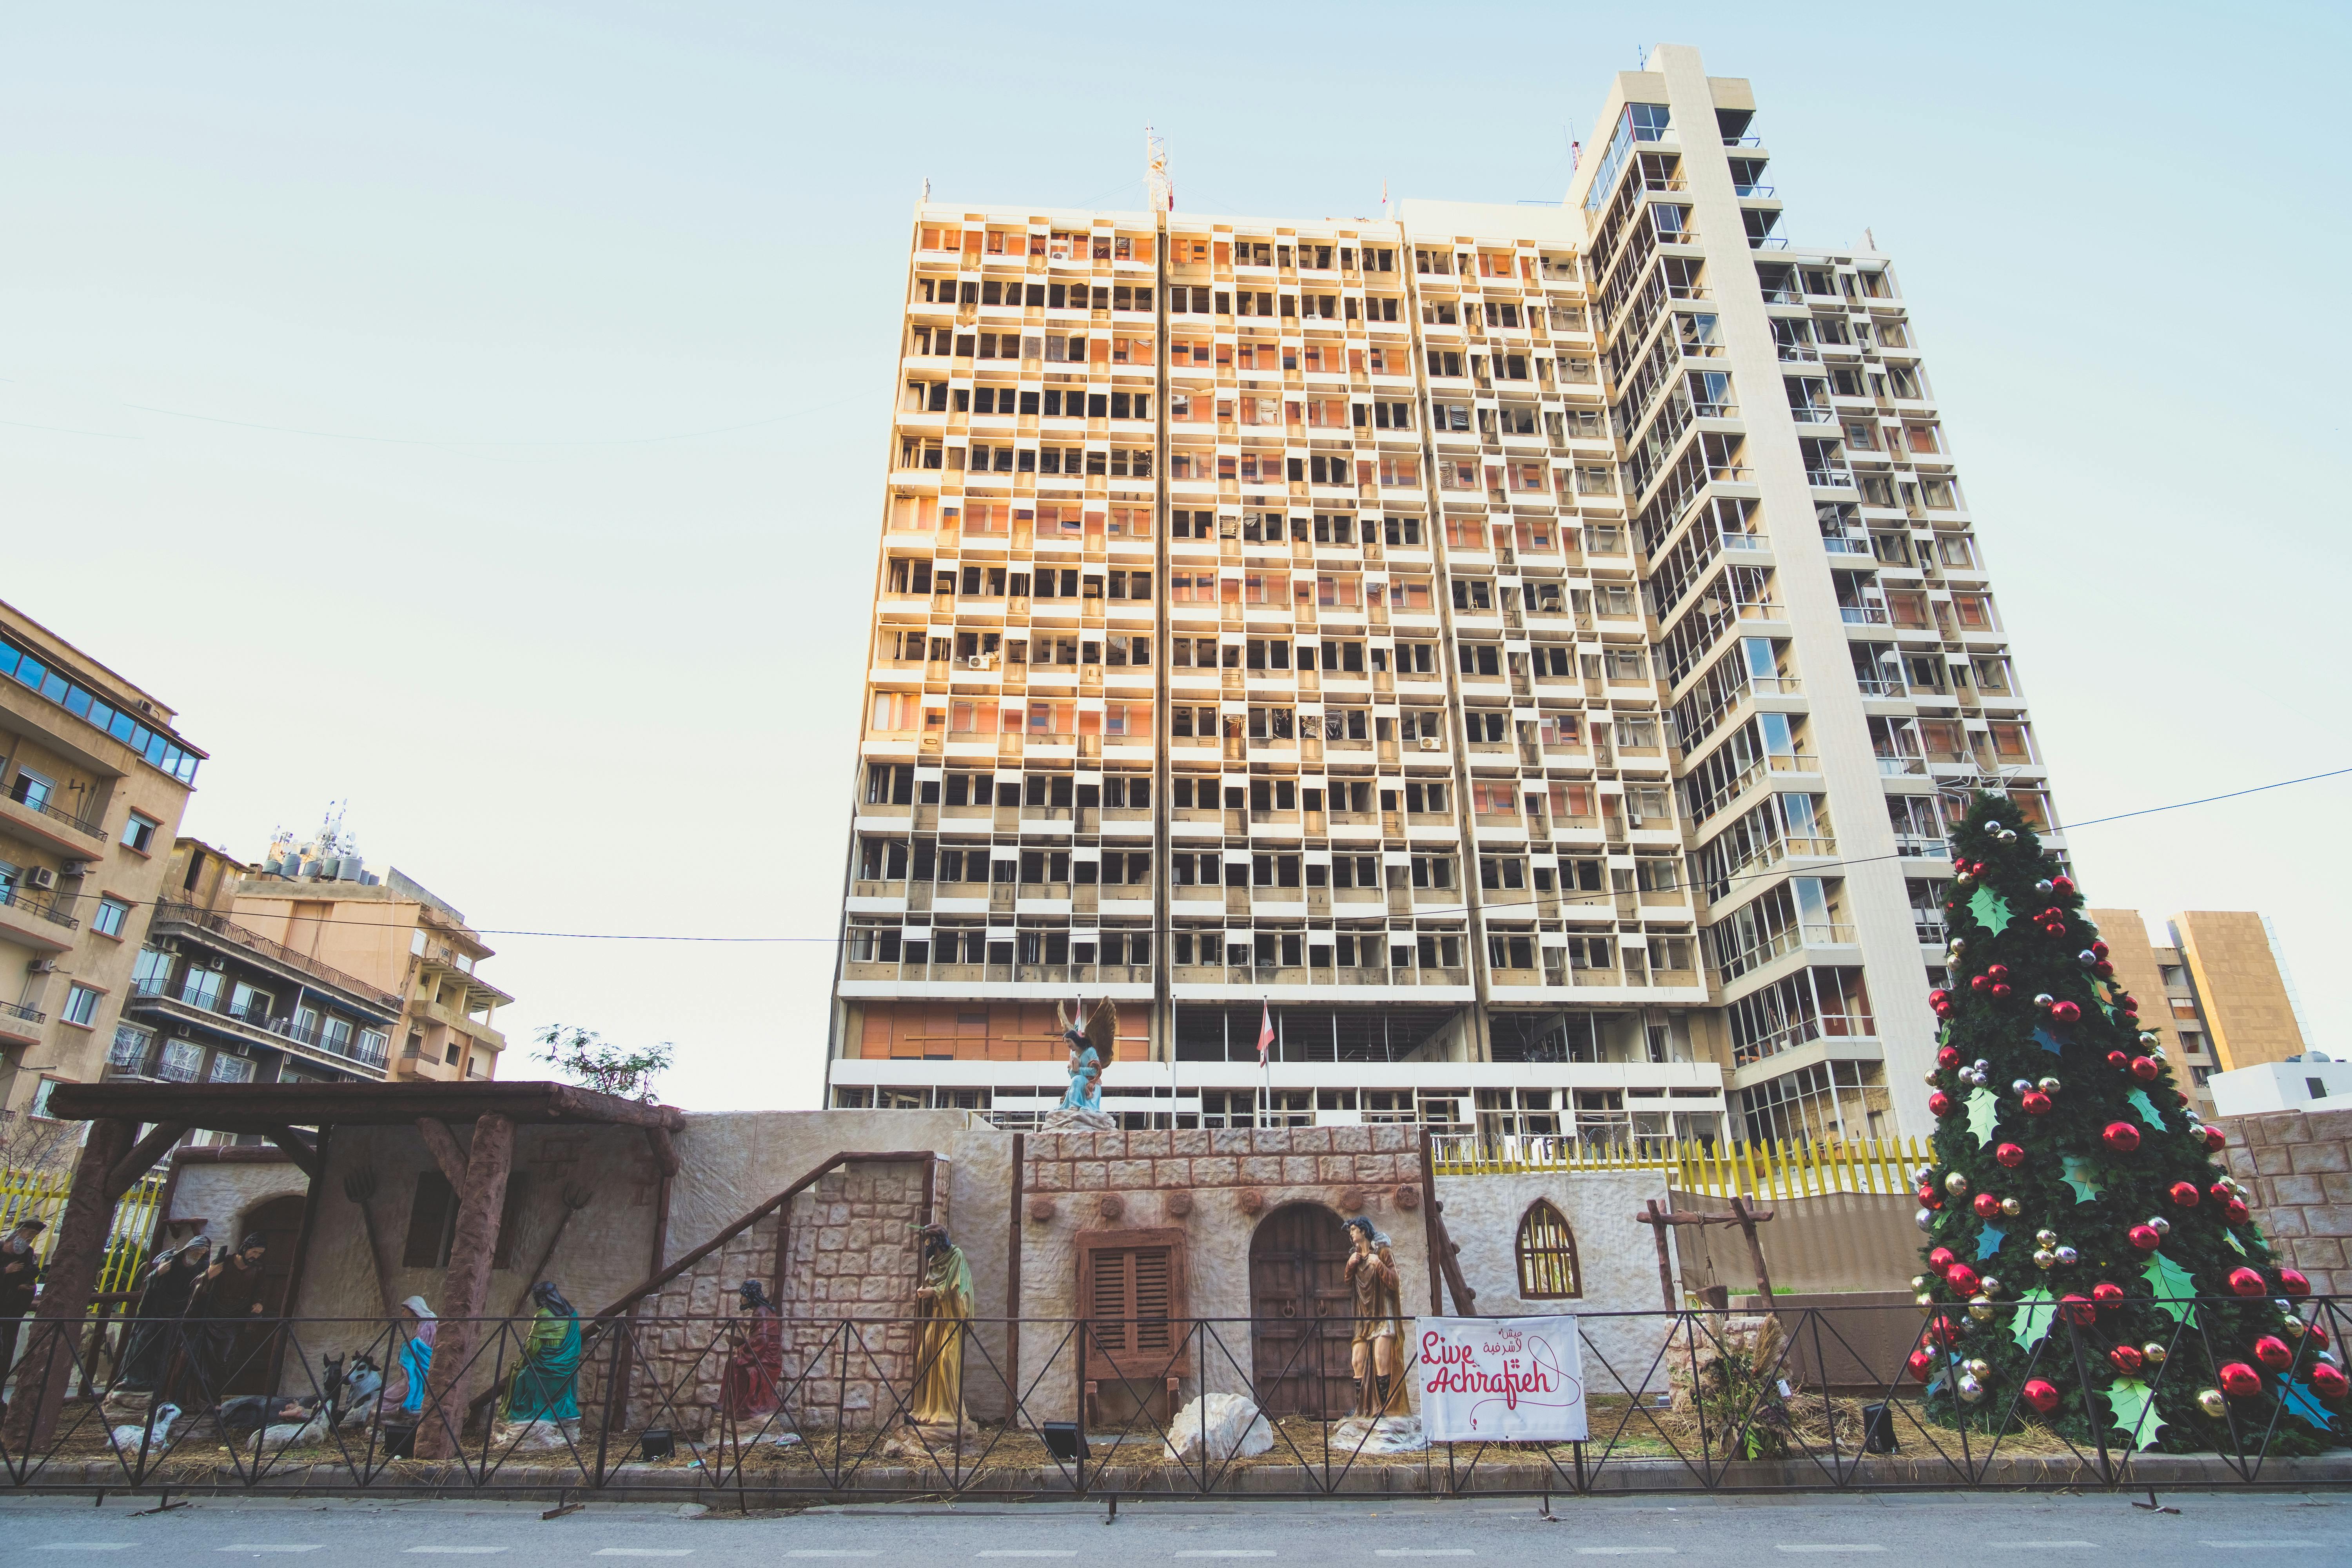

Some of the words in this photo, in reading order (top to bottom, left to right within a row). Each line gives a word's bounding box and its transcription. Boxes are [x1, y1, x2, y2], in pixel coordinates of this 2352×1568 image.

[1421, 1331, 1474, 1364] Live
[1499, 1328, 1523, 1339] عيش
[1426, 1359, 1550, 1410] Achrafieh
